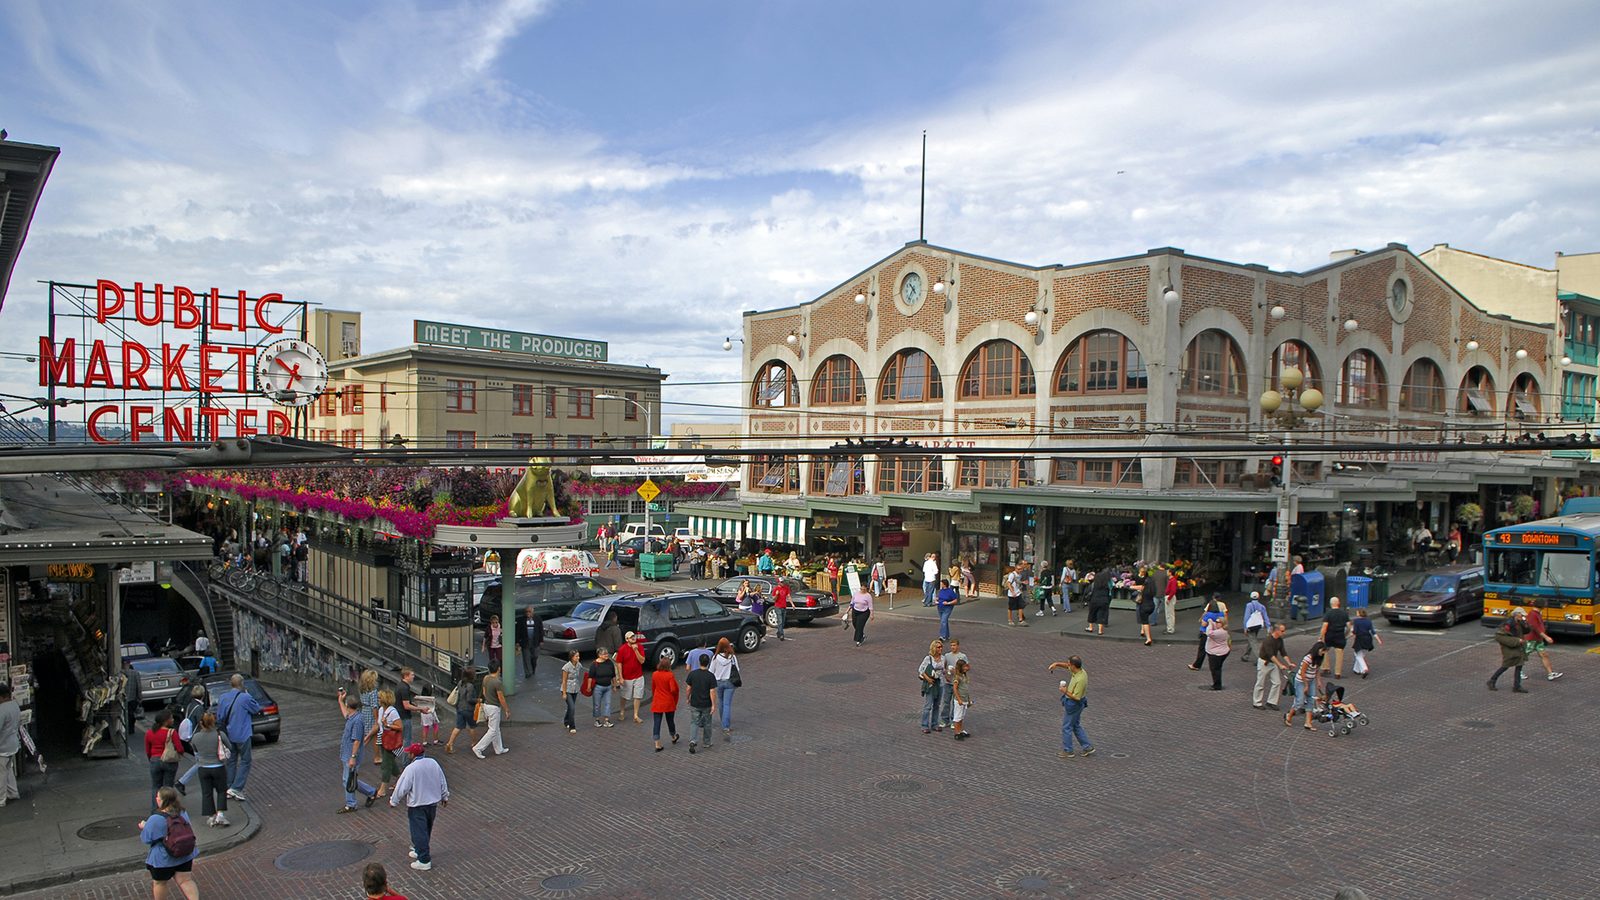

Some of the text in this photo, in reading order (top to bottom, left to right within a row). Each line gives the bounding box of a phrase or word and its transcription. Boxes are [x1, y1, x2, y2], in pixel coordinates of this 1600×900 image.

[97, 279, 283, 334] PUBLIC
[424, 325, 602, 358] MEET THE PRODUCER
[39, 336, 257, 393] MARKET
[87, 405, 292, 446] CENTER
[1340, 450, 1438, 463] CORNER MARKET
[1063, 506, 1140, 518] PIKE PLACE FLOWERS
[1500, 533, 1559, 545] 43 DOWNTOWN
[48, 563, 95, 579] NEWS
